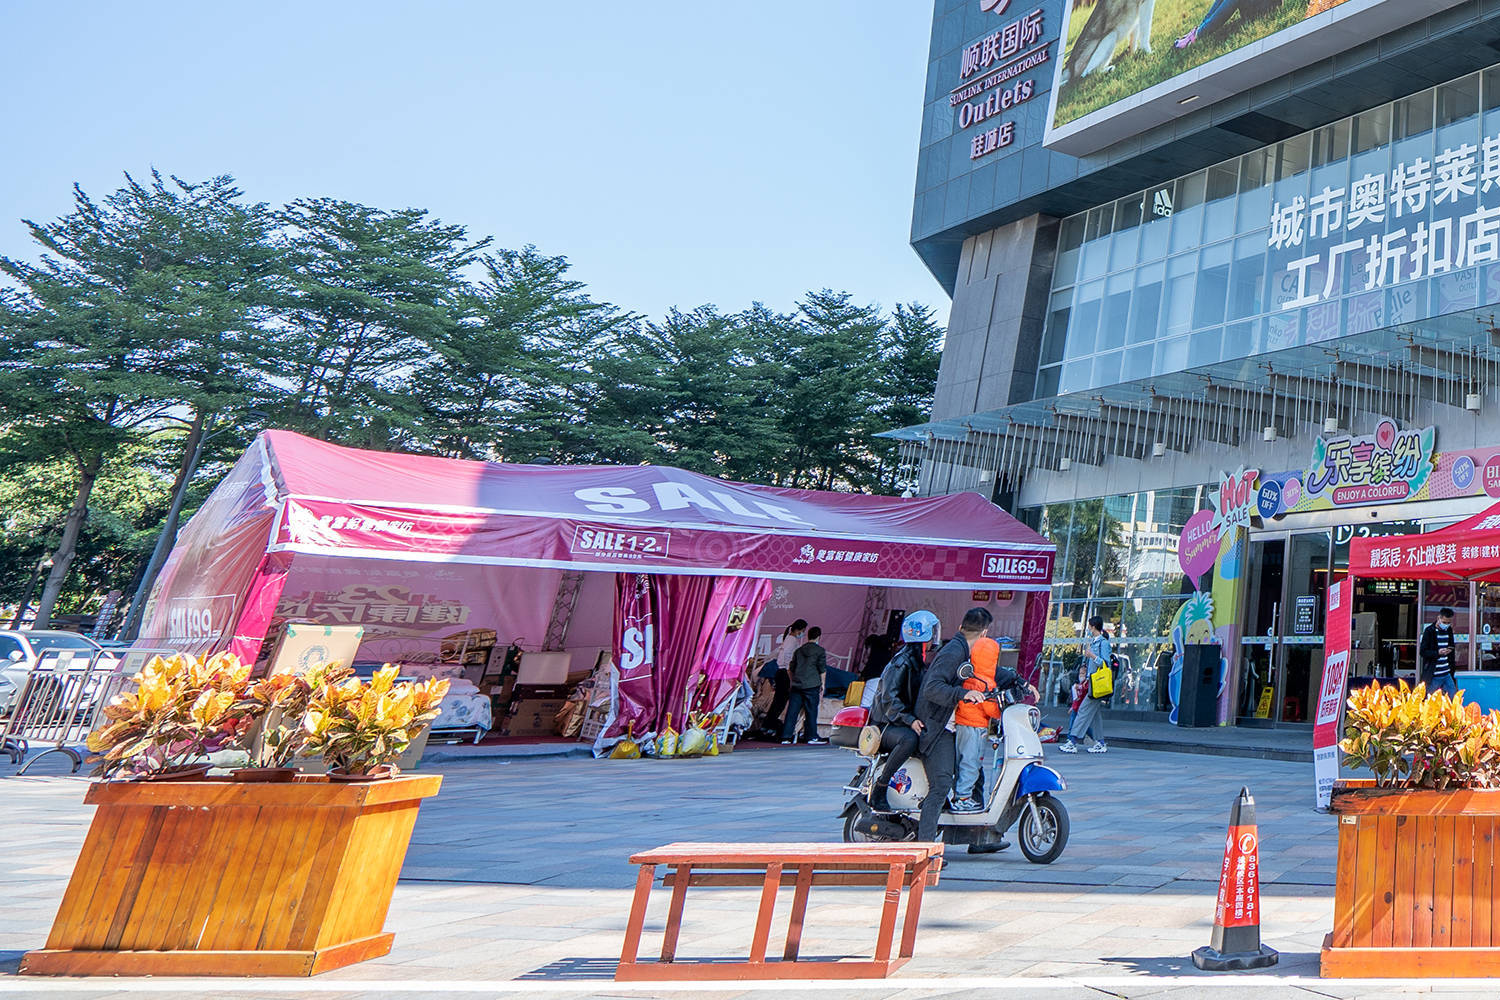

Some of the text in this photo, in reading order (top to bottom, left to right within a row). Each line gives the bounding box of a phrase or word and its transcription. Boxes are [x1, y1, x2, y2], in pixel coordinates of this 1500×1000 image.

[960, 9, 1043, 79] 顺联国际
[950, 50, 1049, 106] SUNLINK INTERNATIONAL
[959, 79, 1034, 130] Outlets
[970, 121, 1015, 160] 桂城店
[1282, 206, 1500, 310] 工厂折扣店
[1308, 433, 1421, 495] 乐享缤纷
[574, 482, 817, 527] SALE
[1220, 471, 1258, 517] HOT
[1261, 500, 1273, 510] OFF
[1337, 484, 1407, 501] ENJOY A COLORFUL
[1187, 520, 1212, 543] HELLO
[1226, 507, 1248, 527] SALE
